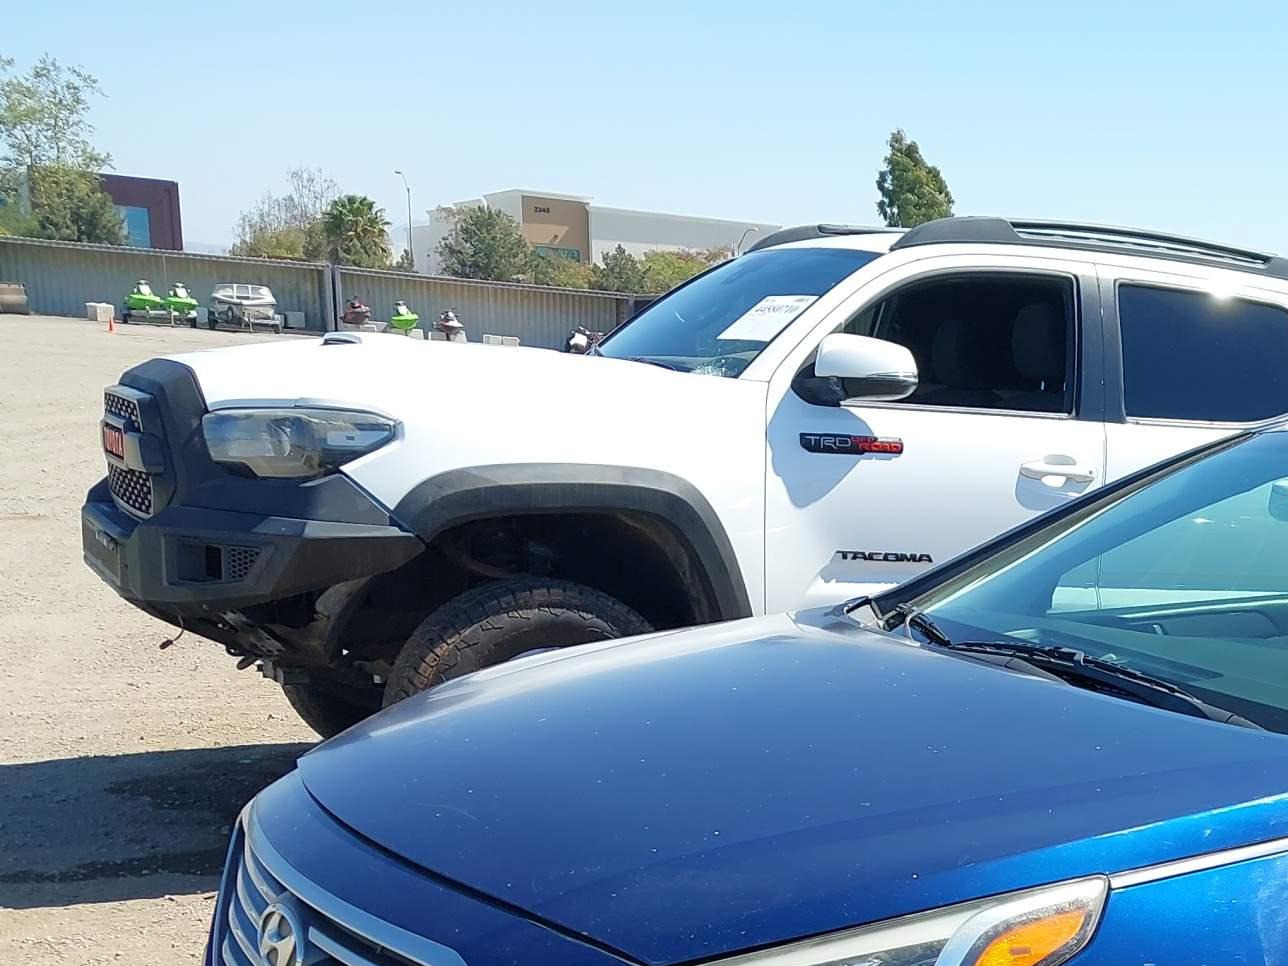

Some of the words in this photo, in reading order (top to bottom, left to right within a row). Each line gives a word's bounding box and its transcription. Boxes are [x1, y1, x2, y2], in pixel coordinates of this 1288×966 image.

[805, 436, 852, 449] TRD
[858, 442, 902, 452] ROAD
[835, 550, 933, 563] TACOMA
